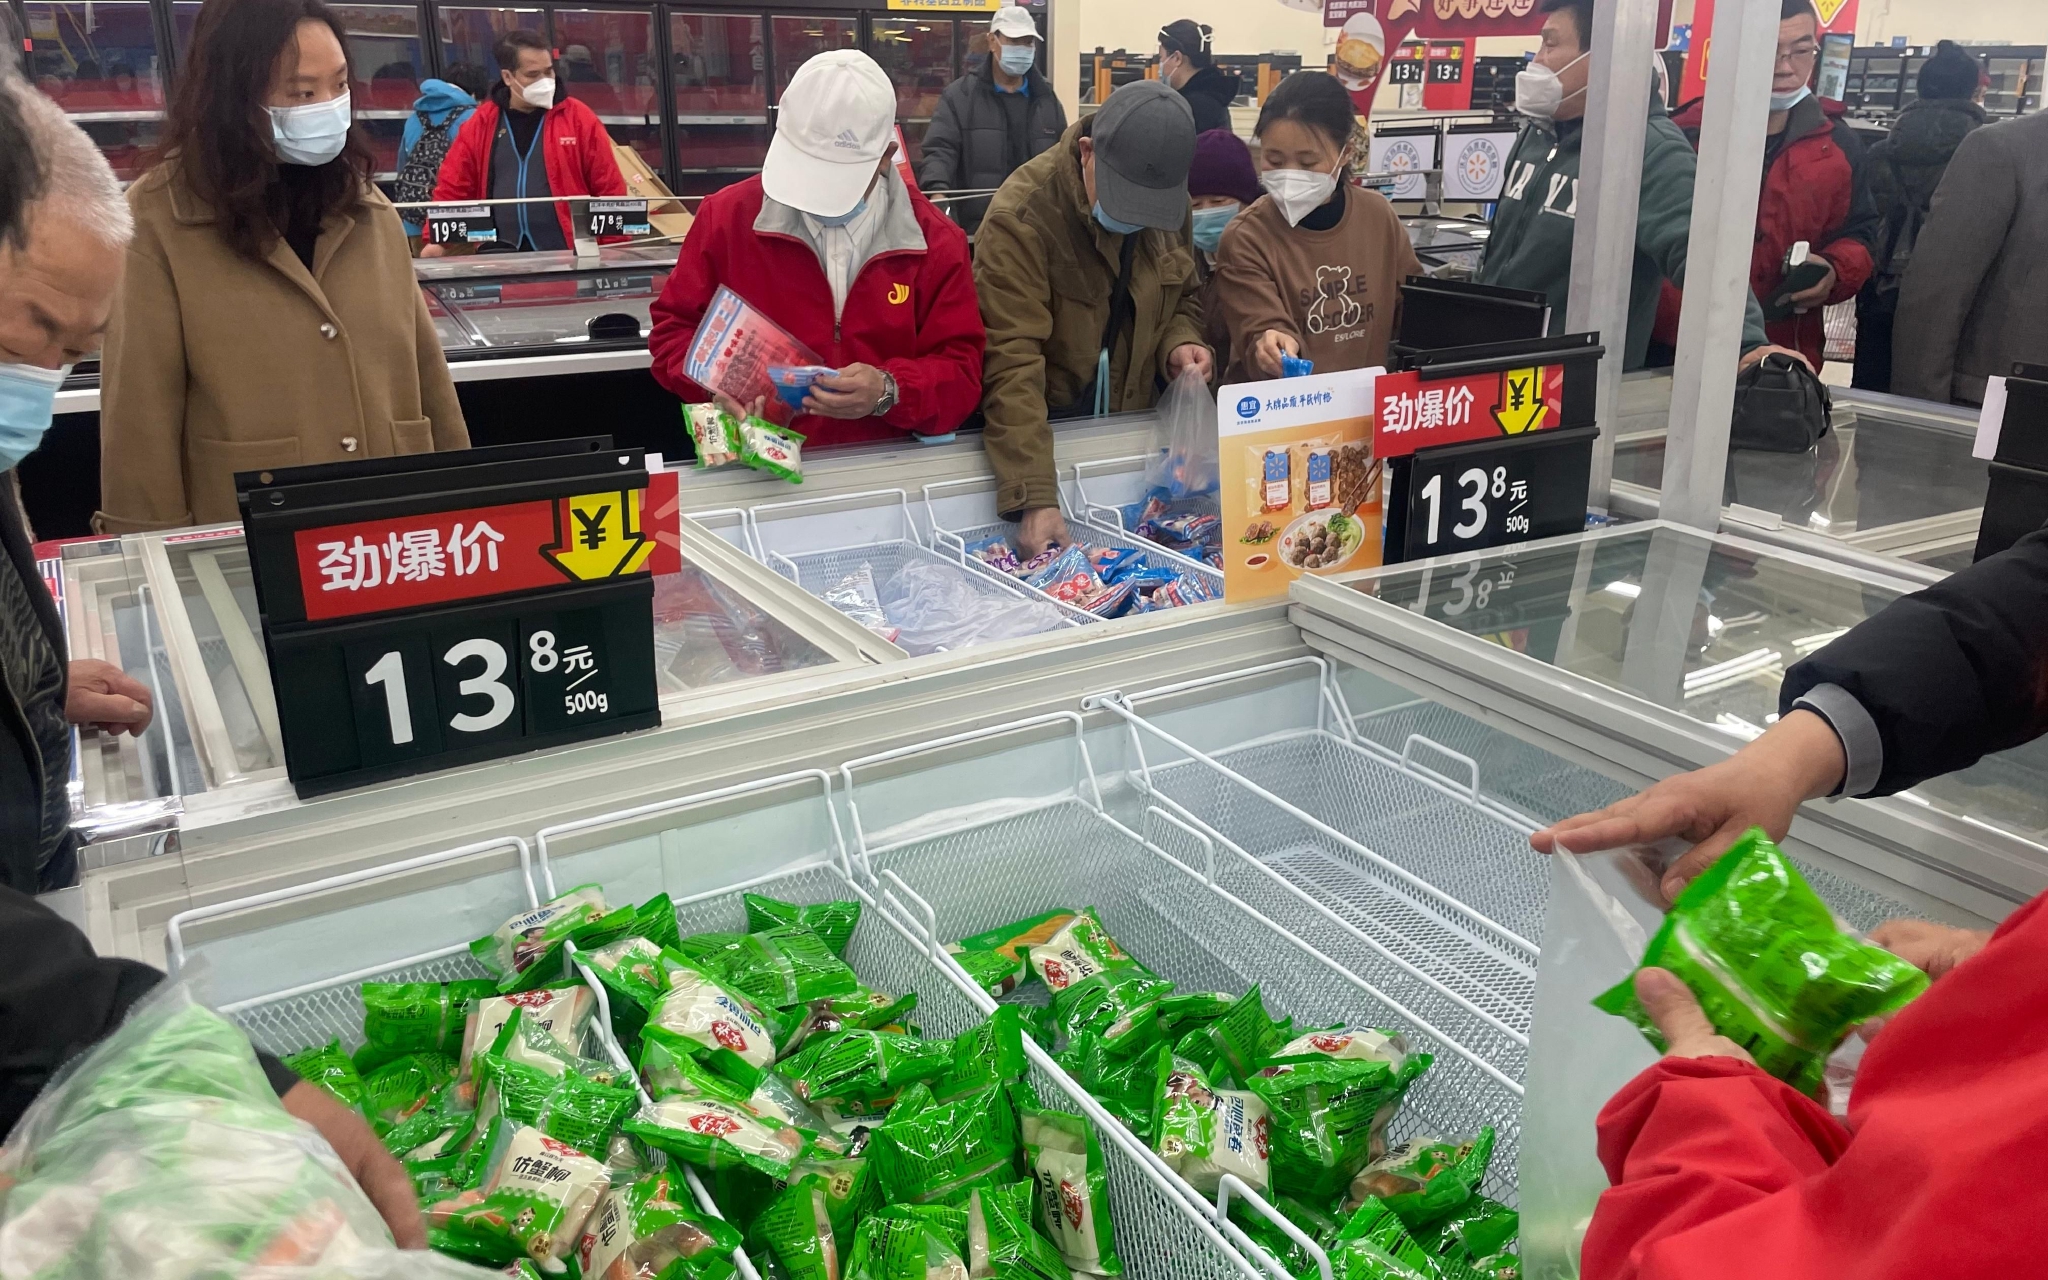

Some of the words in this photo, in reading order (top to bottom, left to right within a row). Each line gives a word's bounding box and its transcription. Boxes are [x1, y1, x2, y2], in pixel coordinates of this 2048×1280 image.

[1396, 64, 1410, 79] 13
[1437, 64, 1450, 79] 13
[834, 140, 861, 150] adidas
[432, 222, 450, 243] 19
[451, 221, 457, 232] 9
[591, 215, 605, 235] 47
[608, 215, 614, 225] 8
[1382, 385, 1474, 434] 劲爆价
[1421, 467, 1488, 545] 13
[1491, 466, 1507, 498] 8
[1506, 515, 1530, 534] 500g
[317, 520, 505, 592] 劲爆价
[365, 638, 515, 745] 13
[528, 630, 559, 673] 8
[564, 690, 609, 716] 500g
[511, 1155, 572, 1183] 仿蟹柳
